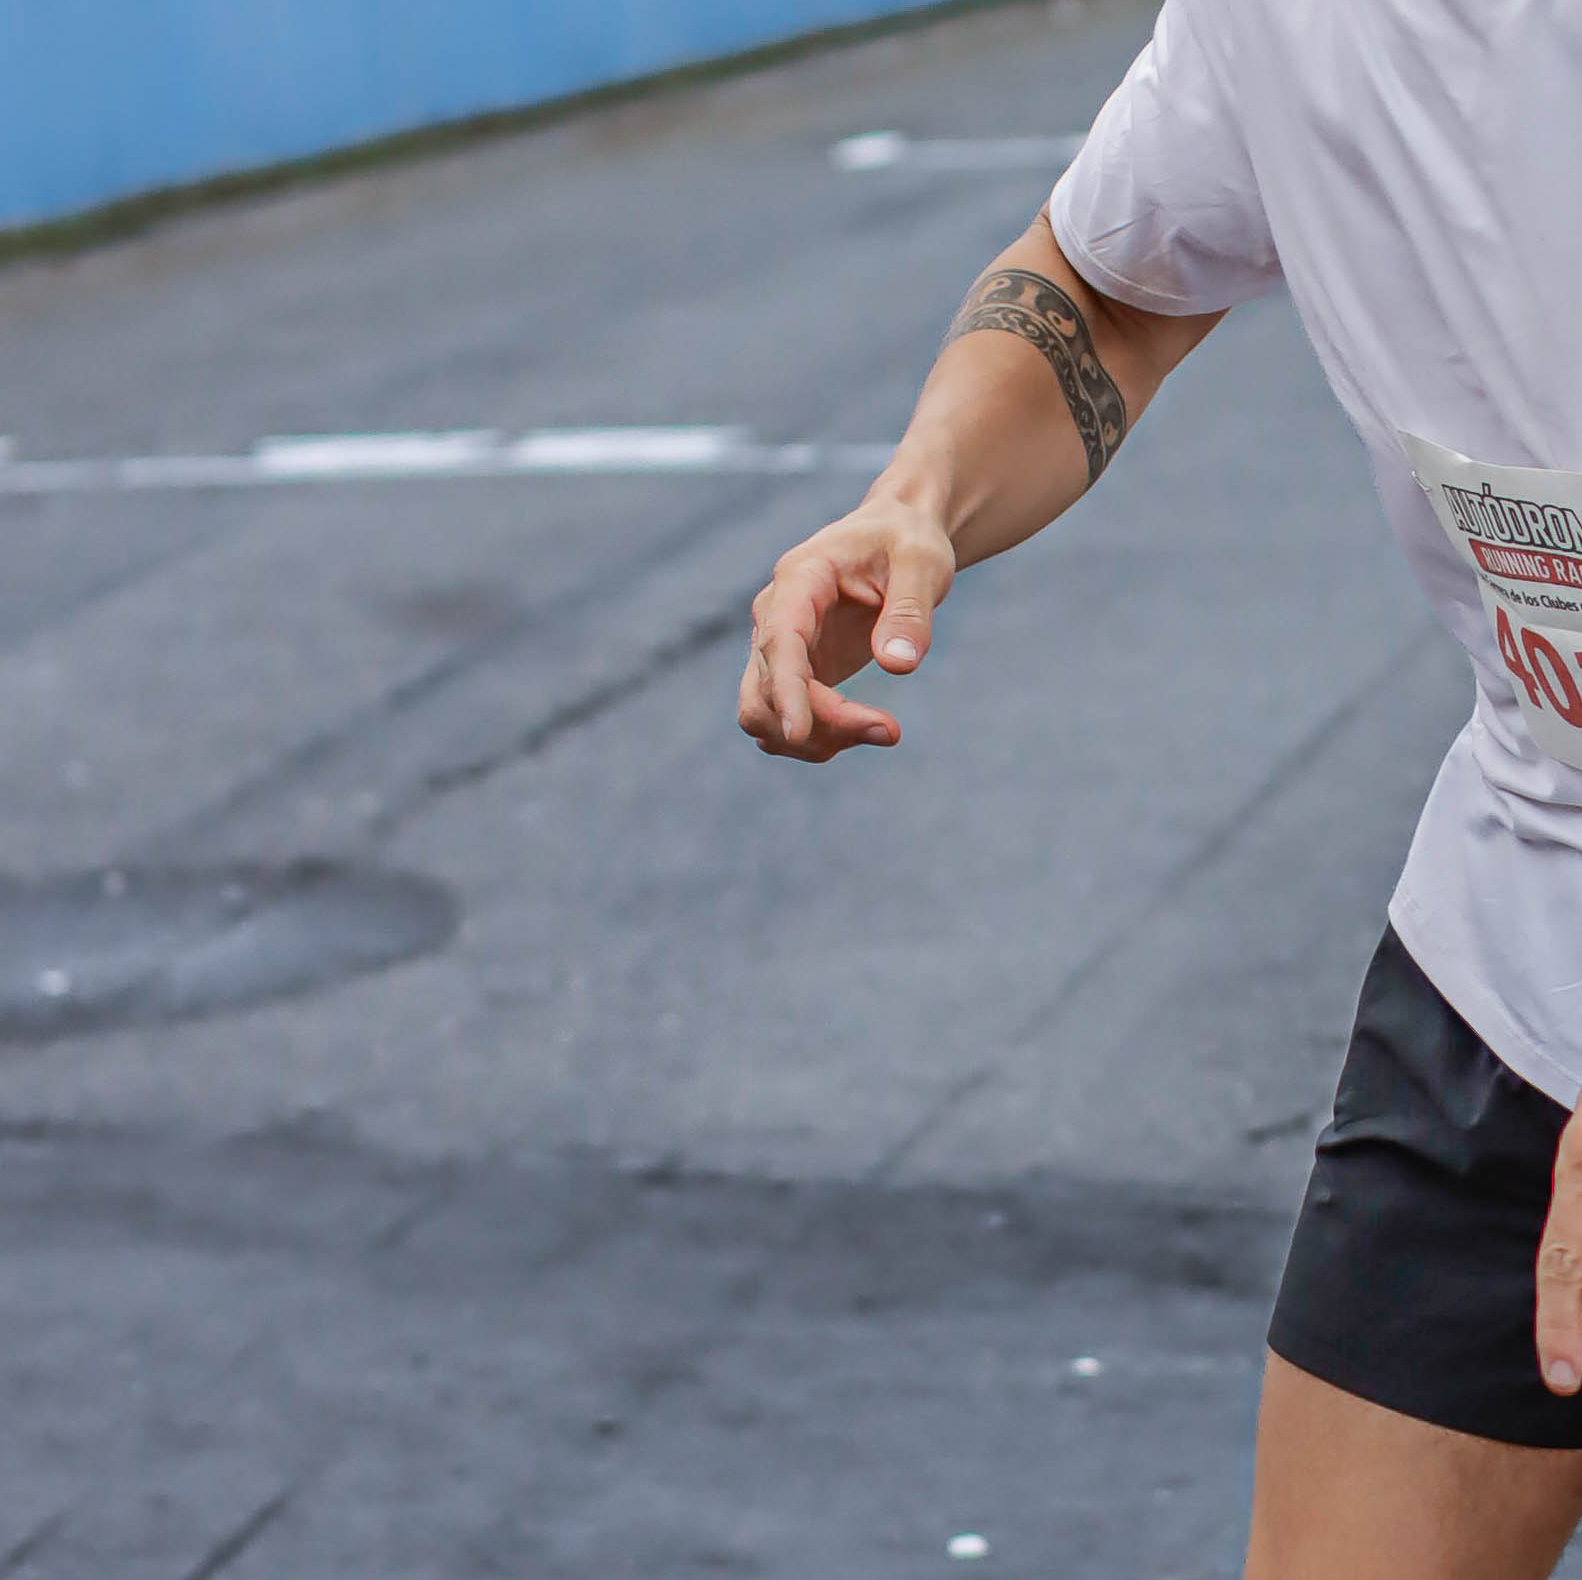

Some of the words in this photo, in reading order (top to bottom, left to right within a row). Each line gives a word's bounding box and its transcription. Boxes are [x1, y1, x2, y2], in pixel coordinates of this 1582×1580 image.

[1480, 546, 1550, 579] RUNNING
[1510, 589, 1522, 604] de
[1522, 591, 1540, 607] los
[1540, 595, 1579, 612] Clubes
